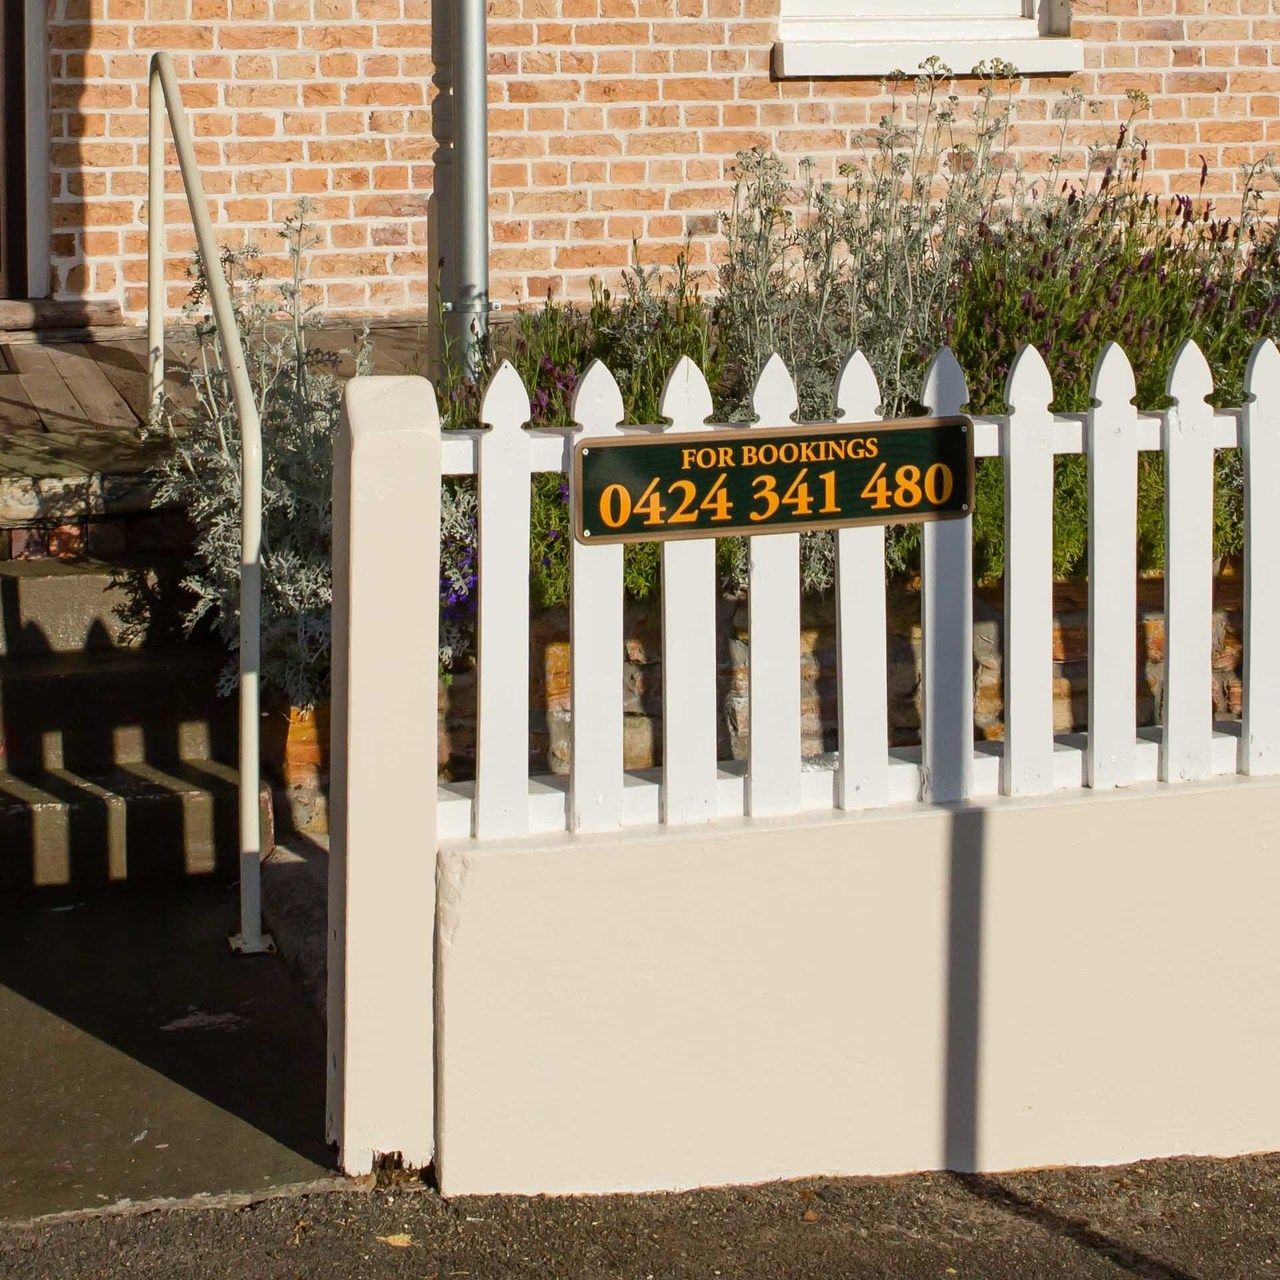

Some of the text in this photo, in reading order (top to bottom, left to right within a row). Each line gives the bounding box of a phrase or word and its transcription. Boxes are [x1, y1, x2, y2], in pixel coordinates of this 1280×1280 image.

[682, 437, 878, 470] FOR BOOKINGS
[599, 462, 953, 528] 0424 341 480
